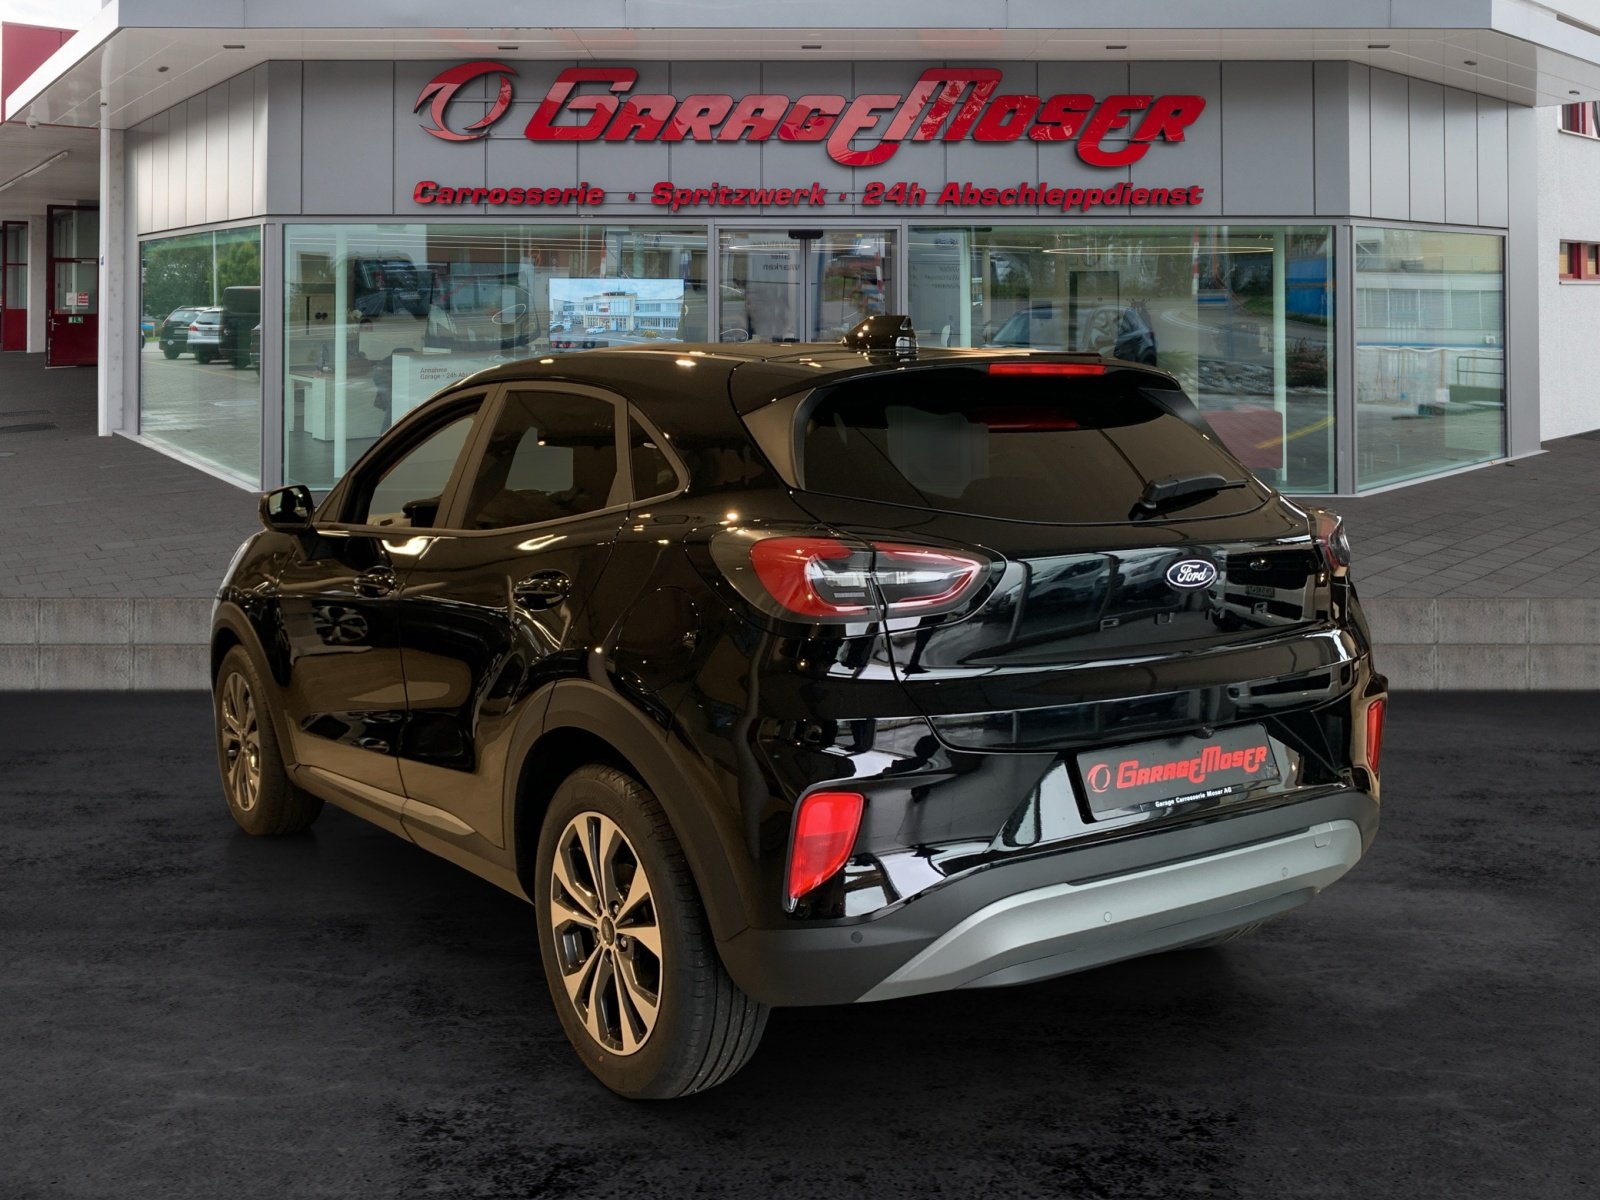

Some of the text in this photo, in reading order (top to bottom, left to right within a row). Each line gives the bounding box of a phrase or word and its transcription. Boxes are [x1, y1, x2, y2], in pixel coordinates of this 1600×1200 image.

[413, 180, 1205, 212] Carrosserie Spritzwerk 24h Abschleppdienst
[1177, 564, 1207, 582] Ford
[1155, 799, 1175, 808] Garage
[1206, 789, 1223, 797] Moser
[1223, 786, 1232, 794] AG
